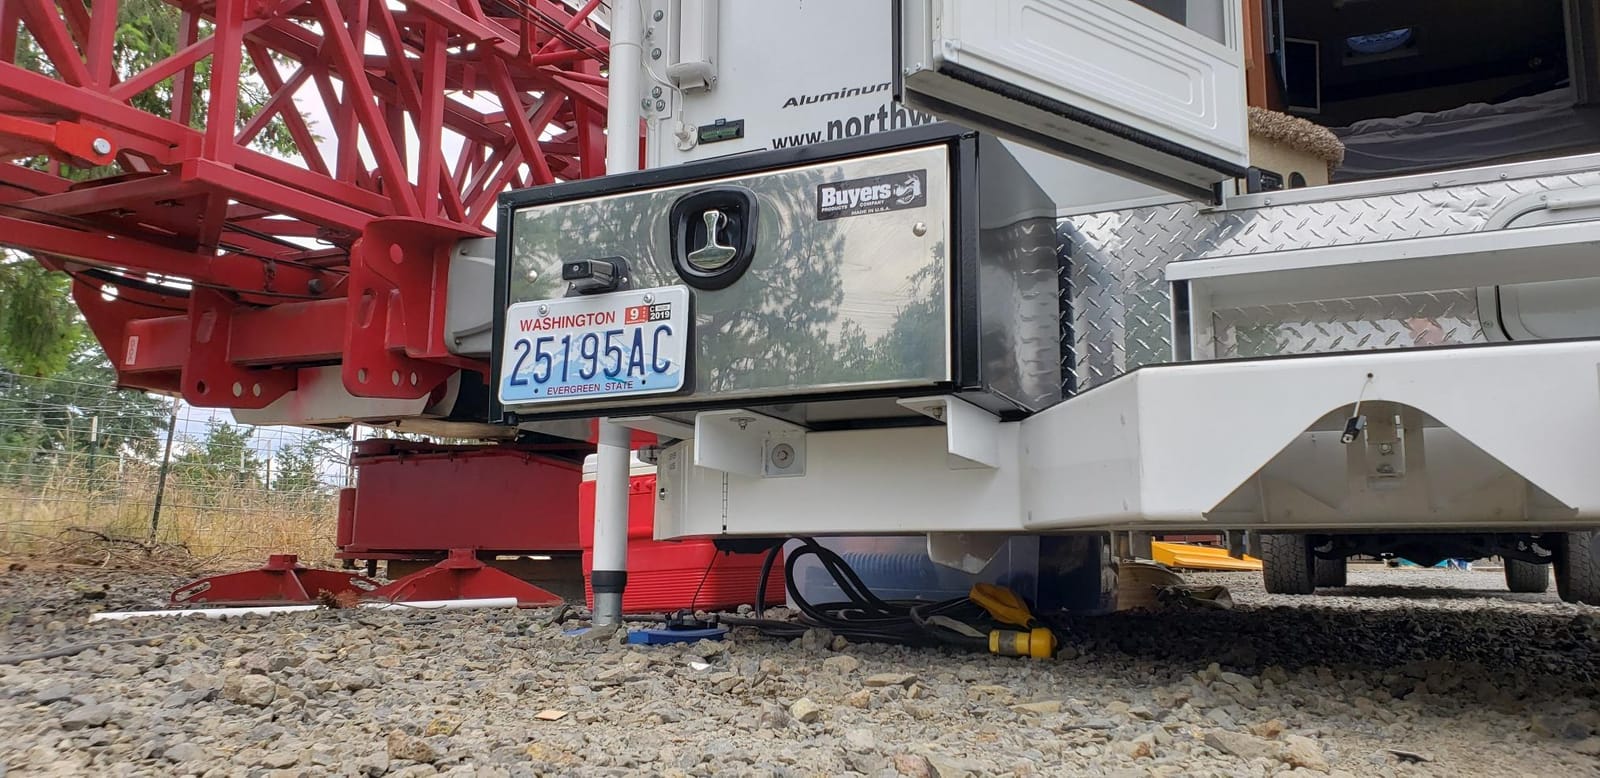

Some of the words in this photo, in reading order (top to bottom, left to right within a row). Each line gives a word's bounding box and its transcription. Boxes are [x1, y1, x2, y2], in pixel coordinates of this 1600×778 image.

[772, 100, 944, 150] www.northw
[822, 183, 892, 208] Buyers
[821, 204, 848, 213] PRODUCTS
[859, 200, 885, 208] COMPANY
[520, 311, 616, 332] WASHINGTON
[630, 308, 640, 321] 9
[650, 310, 670, 321] 2019
[510, 324, 673, 387] 25195AC
[547, 383, 600, 396] EVERGREEN
[605, 380, 634, 391] STATE
